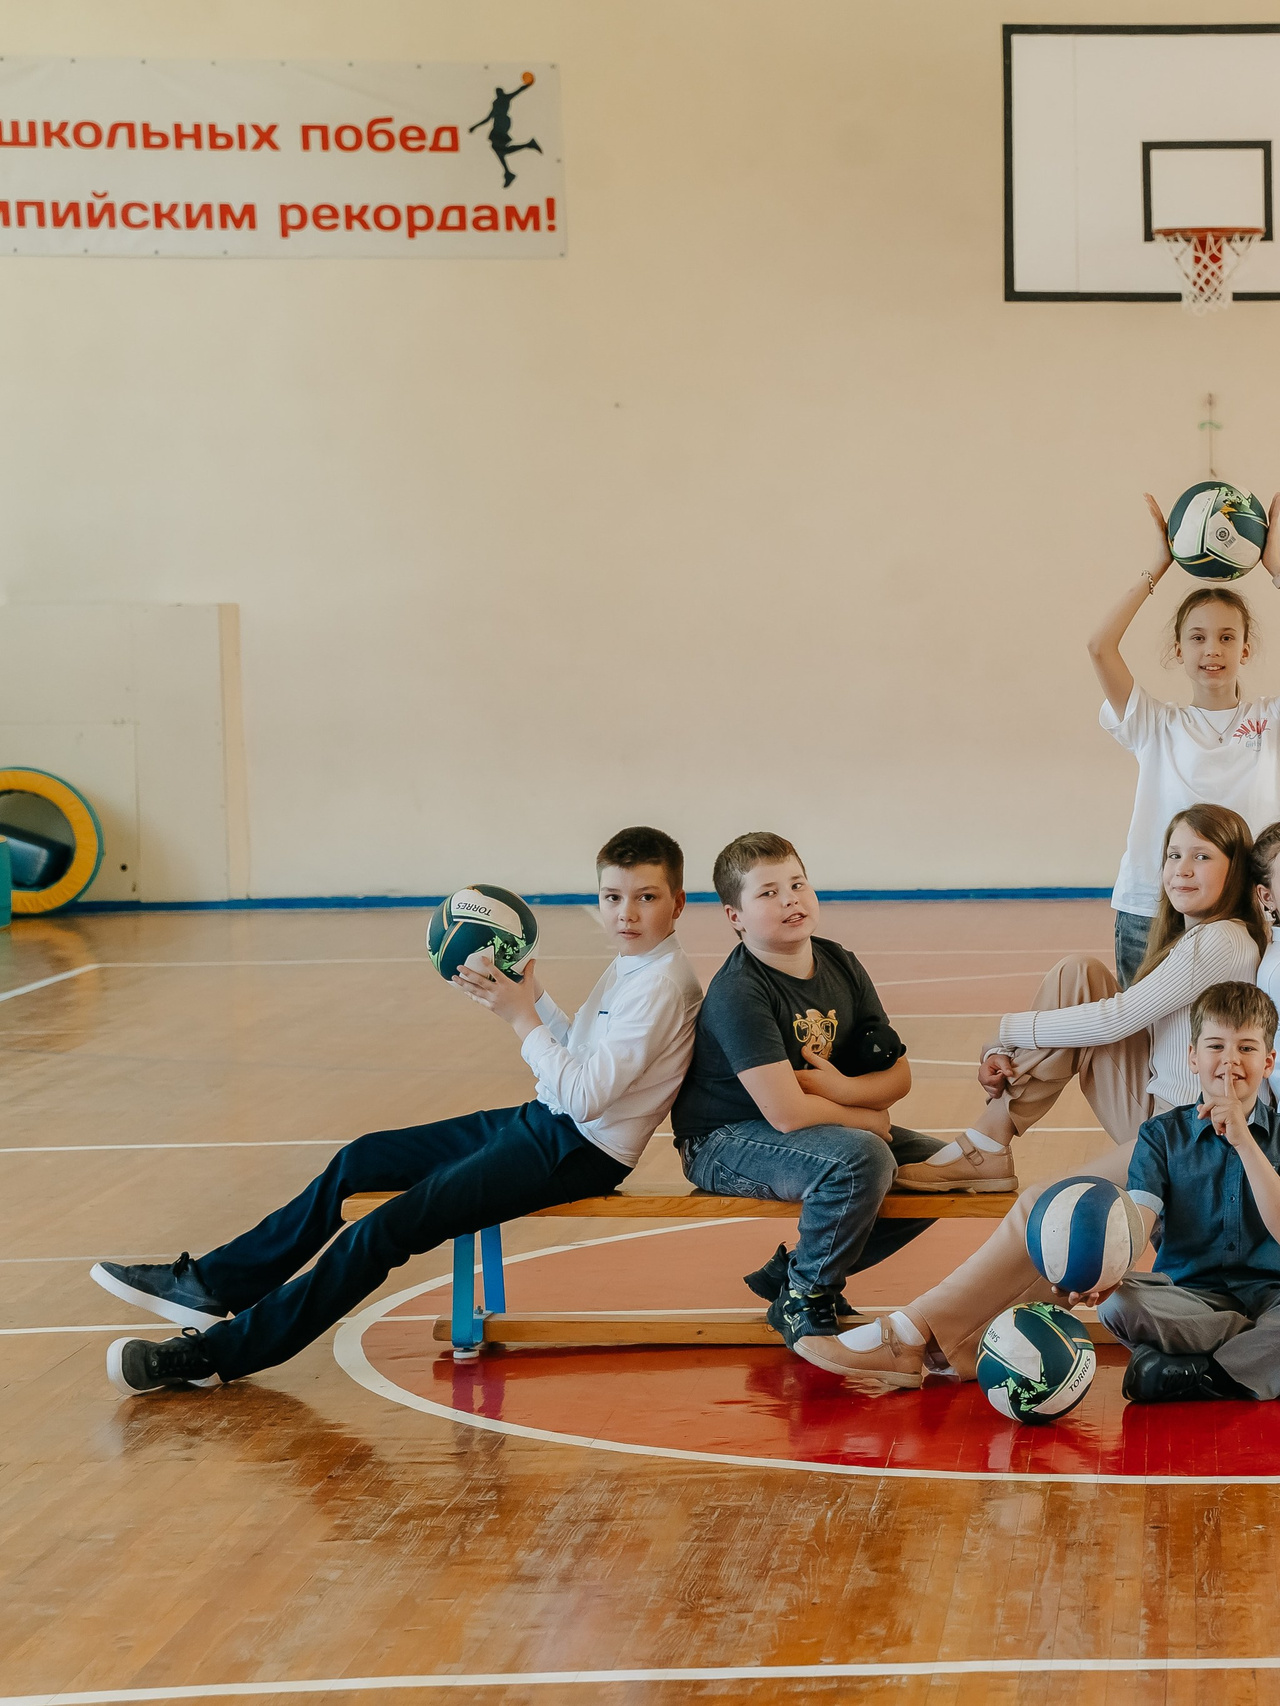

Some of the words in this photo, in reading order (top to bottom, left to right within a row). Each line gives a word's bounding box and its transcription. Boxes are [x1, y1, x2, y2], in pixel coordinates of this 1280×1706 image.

[0, 120, 279, 151] школьных
[300, 116, 460, 153] побед
[0, 192, 257, 231] пийским
[279, 196, 557, 240] рекордам!
[455, 901, 492, 916] TORRES
[1069, 1356, 1091, 1392] TORRES
